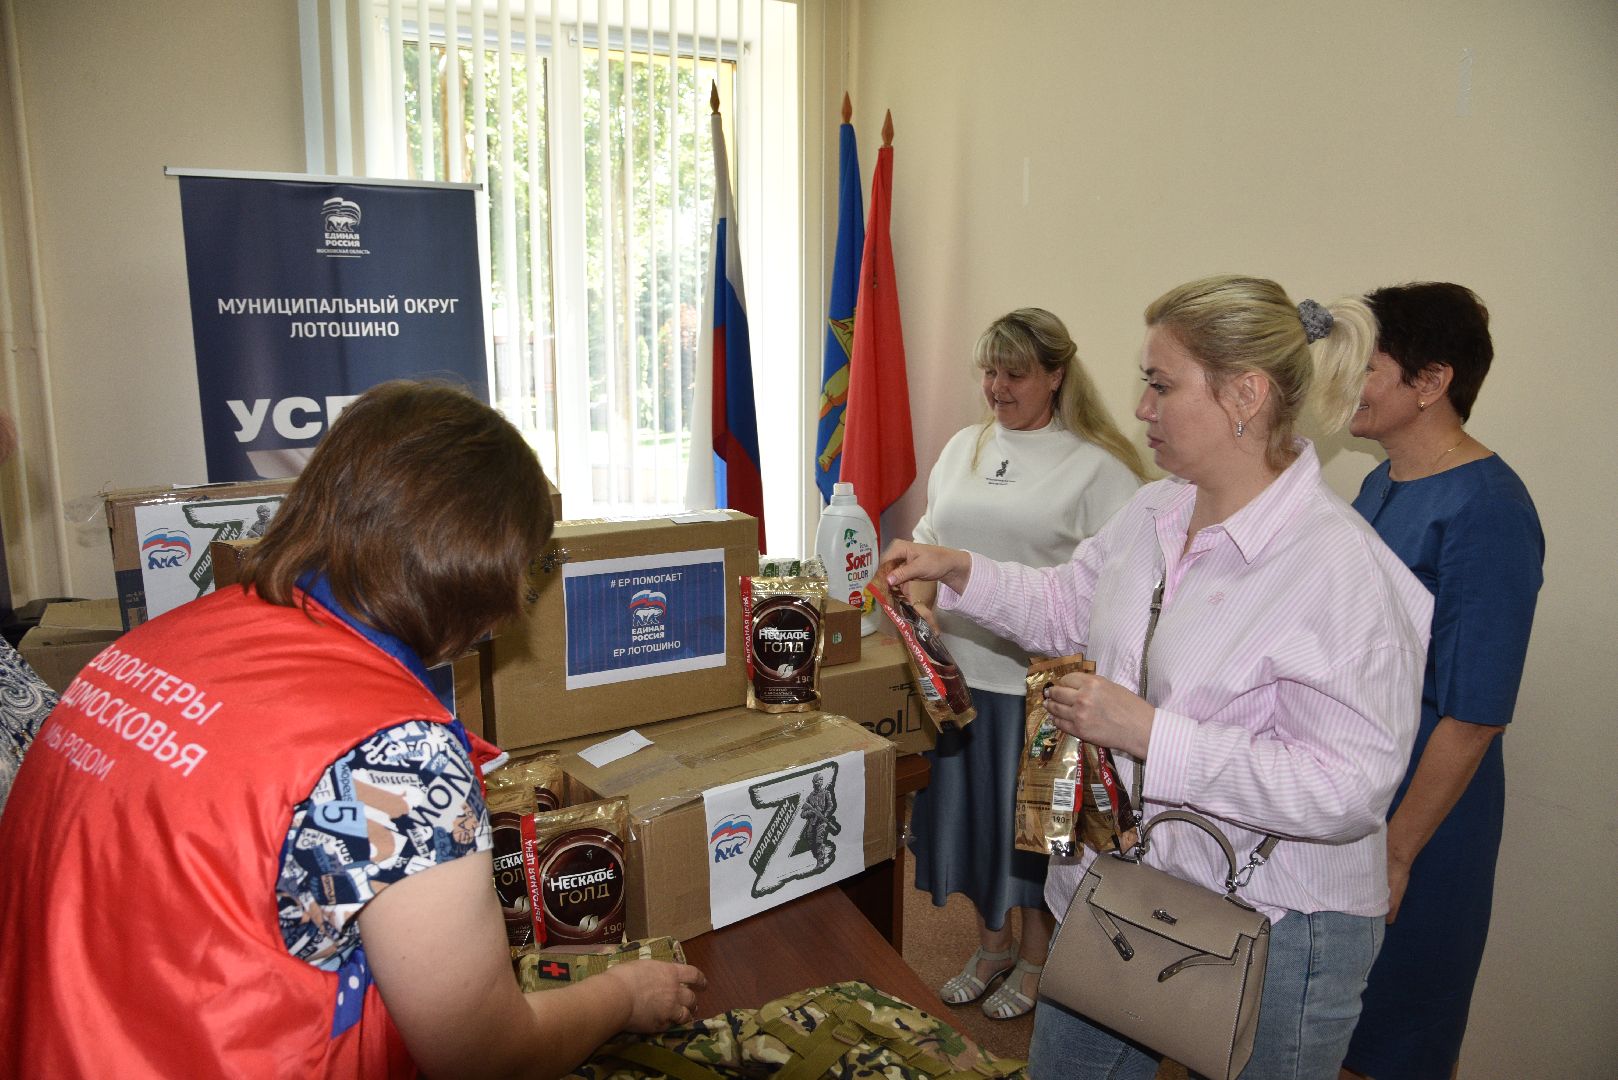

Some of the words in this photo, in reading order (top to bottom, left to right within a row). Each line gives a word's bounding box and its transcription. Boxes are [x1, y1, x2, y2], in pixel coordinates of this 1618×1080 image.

[325, 232, 360, 240] ЕДИНАЯ
[325, 239, 361, 247] РОССИЯ
[217, 295, 399, 316] МУНИЦИПАЛЬНЫЙ
[404, 298, 459, 314] ОКРУГ
[290, 321, 400, 338] ЛОТОШИНО
[618, 578, 631, 587] ЕР
[632, 572, 683, 586] ПОМОГАЕТ
[847, 570, 869, 581] COLOR
[631, 624, 665, 635] ЕДИНАЯ
[631, 632, 665, 643] РОССИЯ
[613, 648, 626, 657] ЕР
[628, 640, 681, 656] ЛОТОШИНО
[764, 641, 805, 653] ГОЛД
[63, 732, 116, 781] РЯДОМ
[322, 804, 357, 824] 5
[752, 799, 791, 867] ПОДДЕРЖИМ
[771, 804, 796, 846] НАШИХ!
[525, 839, 535, 865] ЦЕНА
[550, 865, 616, 892] НЕСКАФЕ
[528, 867, 542, 923] ВЫГОДНАЯ
[559, 883, 610, 907] ГОЛД
[603, 921, 625, 936] 190
